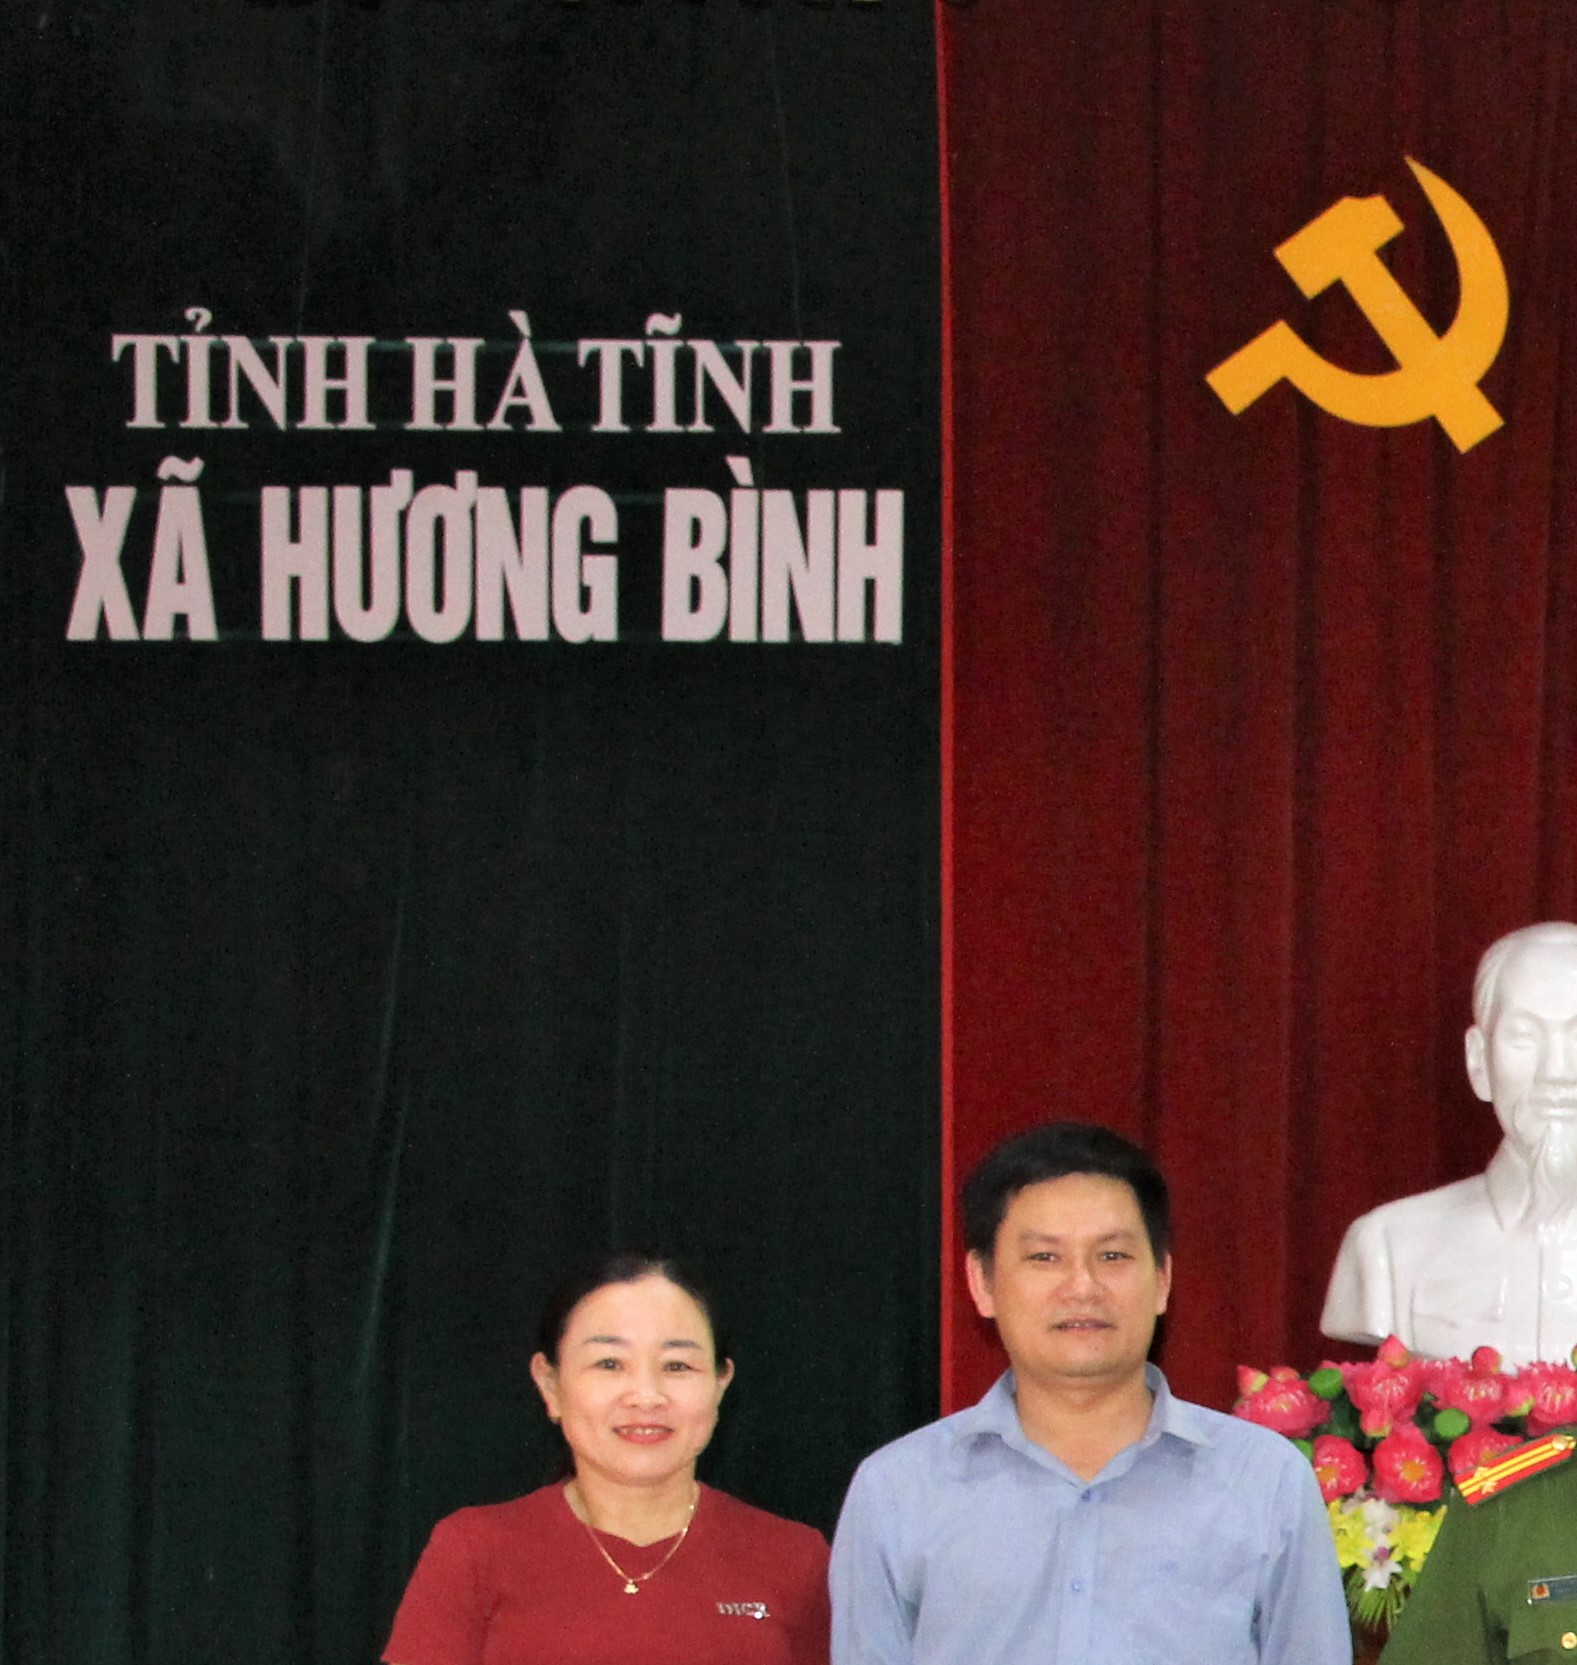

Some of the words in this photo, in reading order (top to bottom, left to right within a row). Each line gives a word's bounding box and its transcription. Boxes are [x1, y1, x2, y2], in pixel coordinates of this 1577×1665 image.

[113, 308, 375, 429] TỈNH
[406, 311, 560, 431] HÀ
[578, 314, 840, 433] TĨNH
[66, 456, 216, 640] XÃ
[262, 469, 617, 643] HƯƠNG
[662, 456, 903, 643] BÌNH
